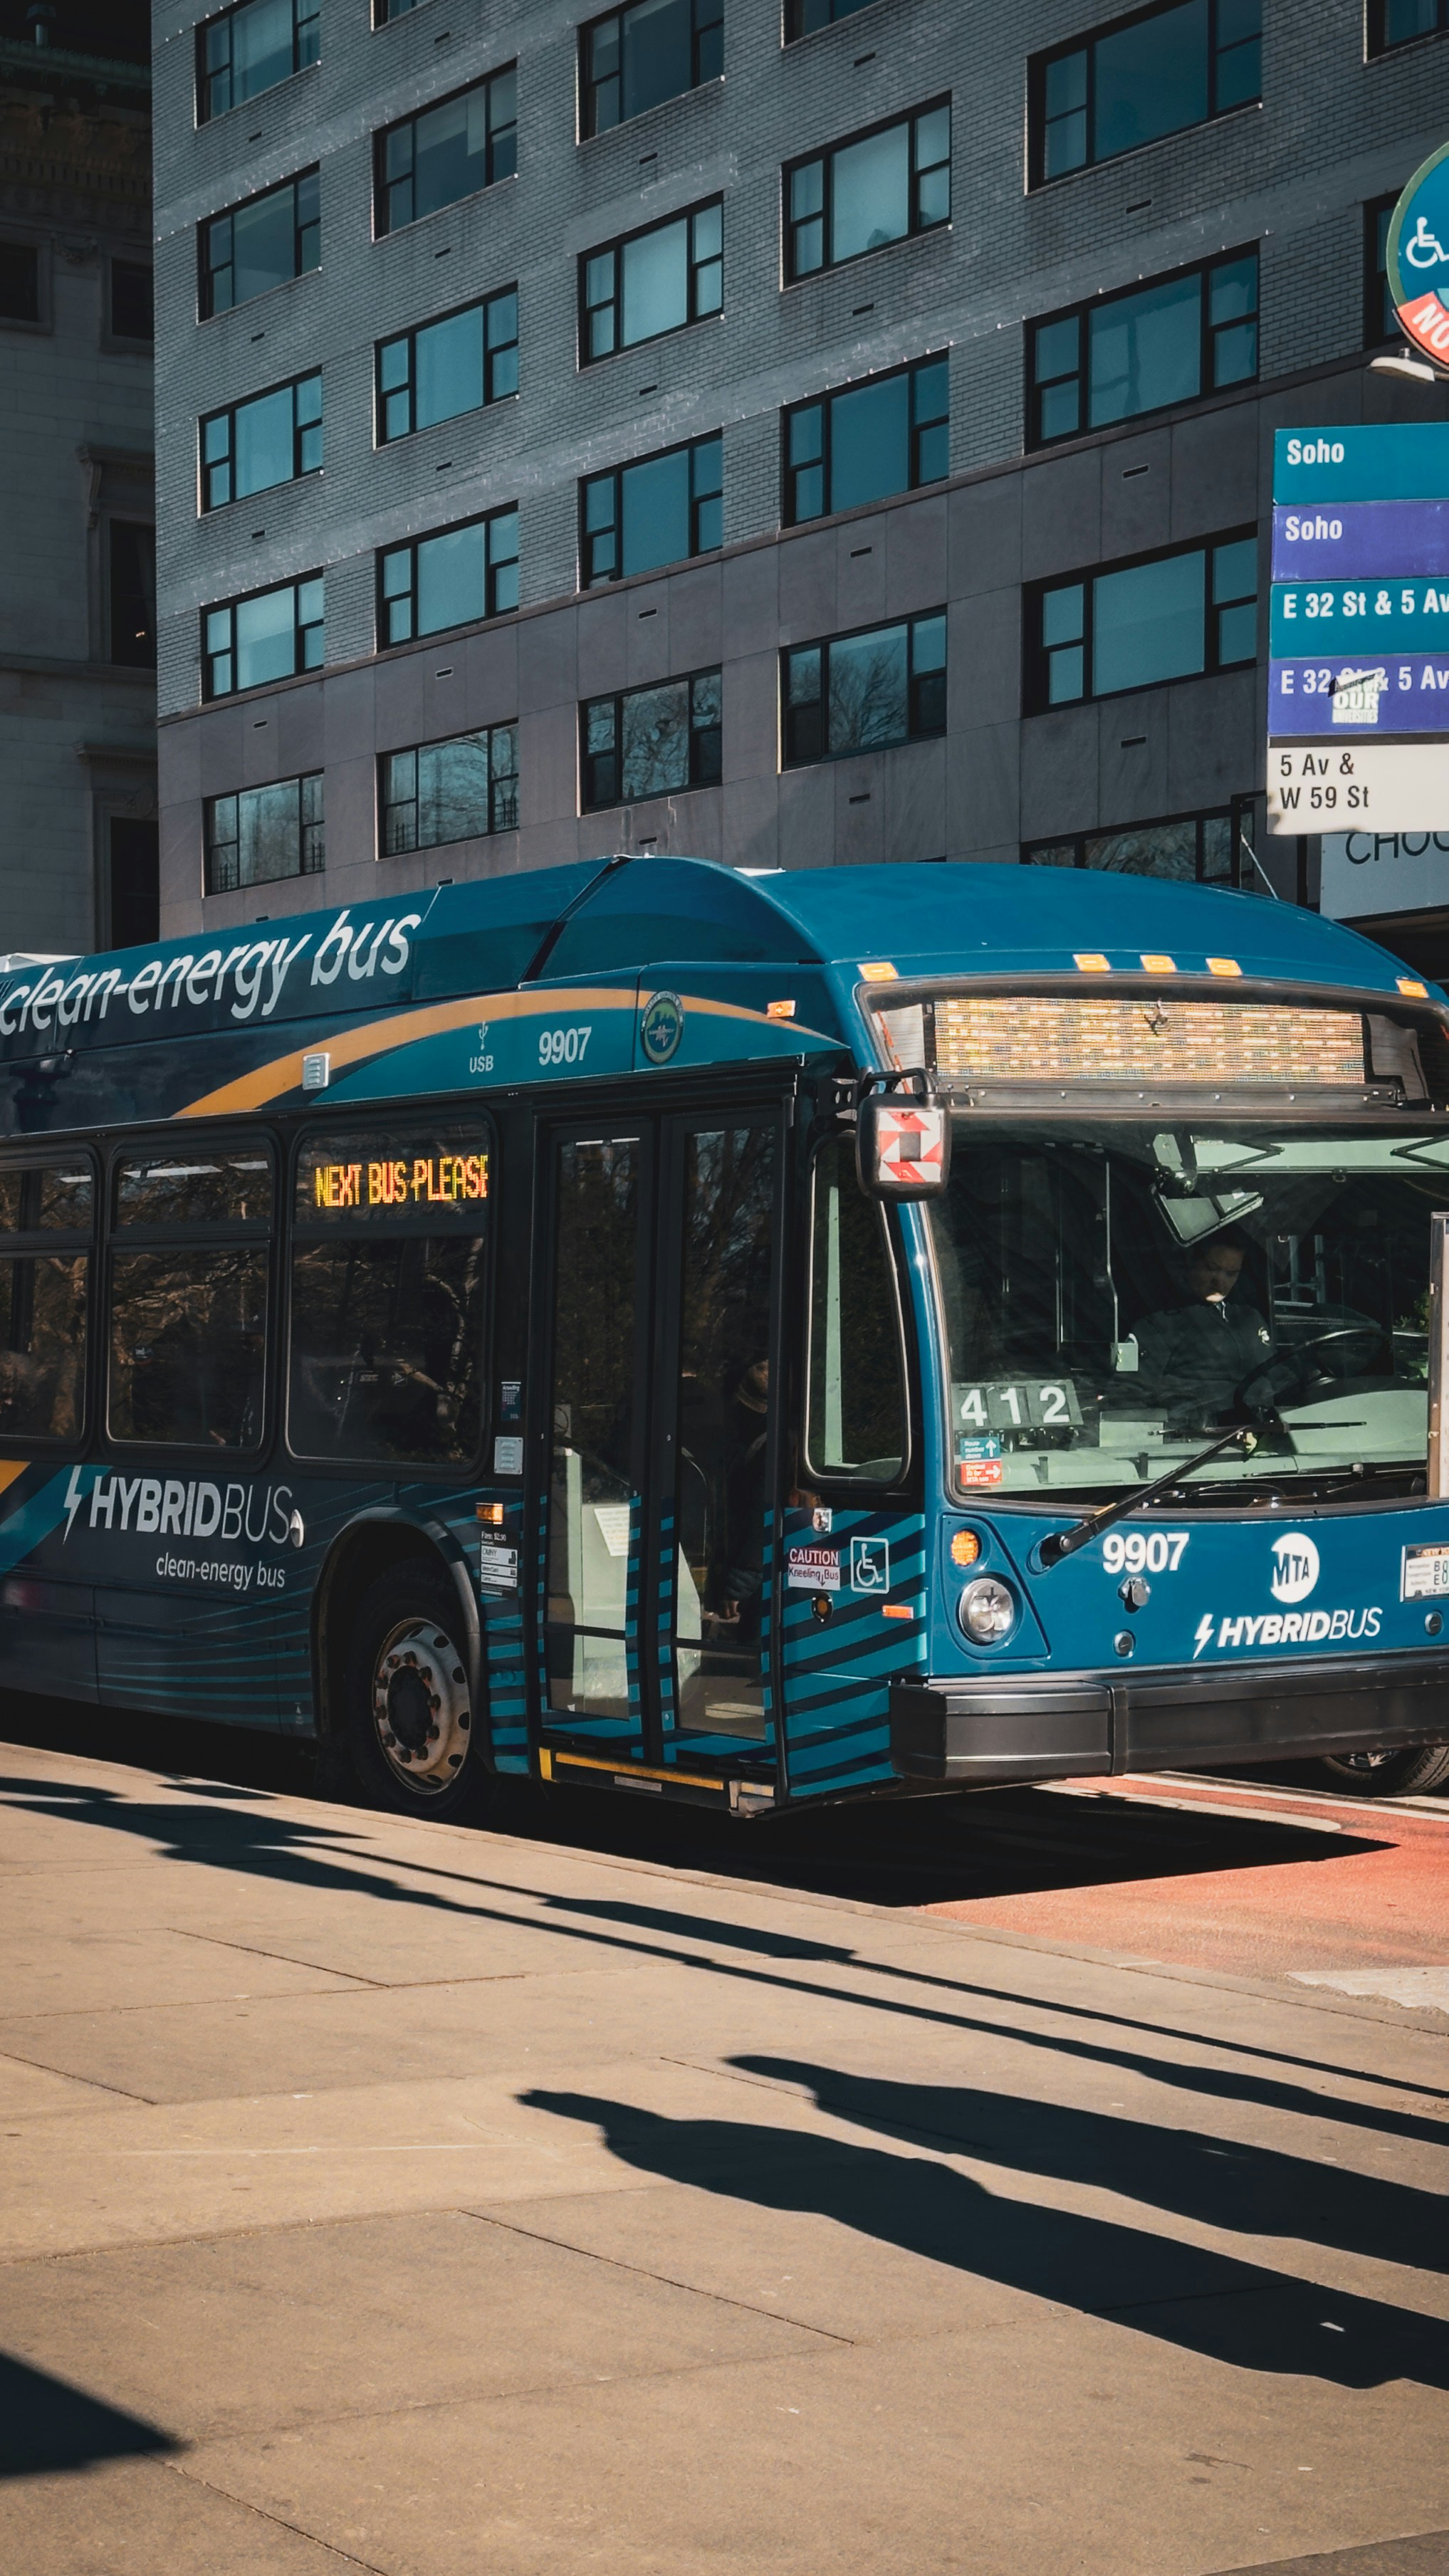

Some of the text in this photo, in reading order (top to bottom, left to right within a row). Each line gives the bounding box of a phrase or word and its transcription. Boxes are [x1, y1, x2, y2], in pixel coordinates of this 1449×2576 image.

[1287, 439, 1344, 465] Soho
[1285, 515, 1342, 541] Soho
[1284, 594, 1297, 618] E
[1305, 592, 1334, 617] 32
[1342, 591, 1366, 617] St
[1375, 590, 1391, 615] &
[1401, 590, 1415, 614] 5
[1282, 669, 1294, 694] E
[1303, 668, 1331, 693] 32
[1398, 666, 1412, 691] 5
[1421, 665, 1449, 690] Av
[1333, 692, 1379, 709] OUR
[1280, 753, 1354, 776] 5 Av &
[1280, 785, 1369, 809] W 59 St
[0, 910, 422, 1035] clean-energy bus
[539, 1027, 592, 1065] 9907
[469, 1055, 493, 1073] USB
[315, 1164, 362, 1207] NEXT
[368, 1161, 407, 1205] BUS
[89, 1476, 293, 1544] HYBRIDBUS
[790, 1548, 839, 1566] CAUTION
[1102, 1533, 1190, 1574] 9907
[156, 1552, 286, 1591] clean-energy bus
[788, 1567, 839, 1581] Kneeling Bus
[1271, 1551, 1309, 1588] MTA
[1218, 1607, 1383, 1648] HYBRIDBUS
